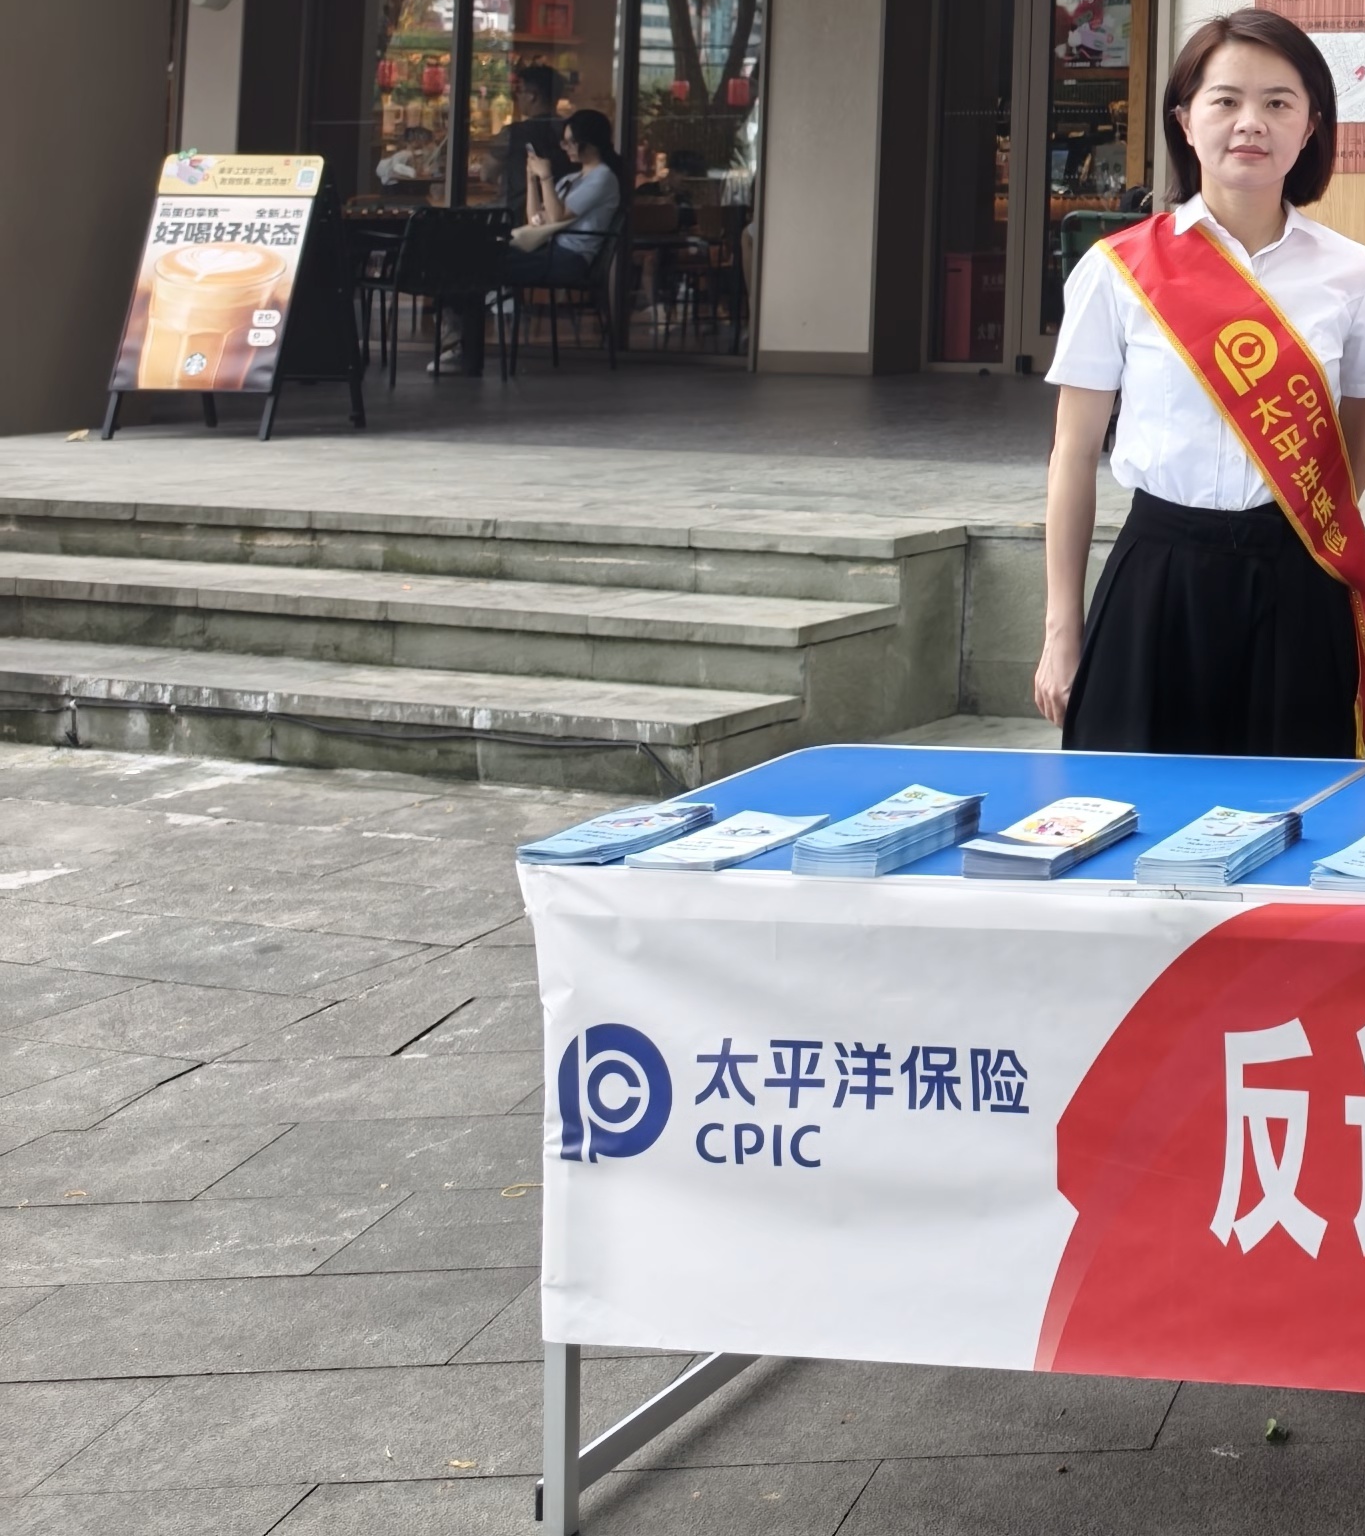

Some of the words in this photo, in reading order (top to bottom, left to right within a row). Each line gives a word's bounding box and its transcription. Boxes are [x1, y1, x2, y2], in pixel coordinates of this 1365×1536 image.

[152, 221, 301, 245] 好喝好状态
[1286, 373, 1329, 440] CPIC
[1249, 394, 1349, 557] 太平洋保险
[694, 1035, 1031, 1118] 太平洋保险
[694, 1119, 823, 1170] CPIC
